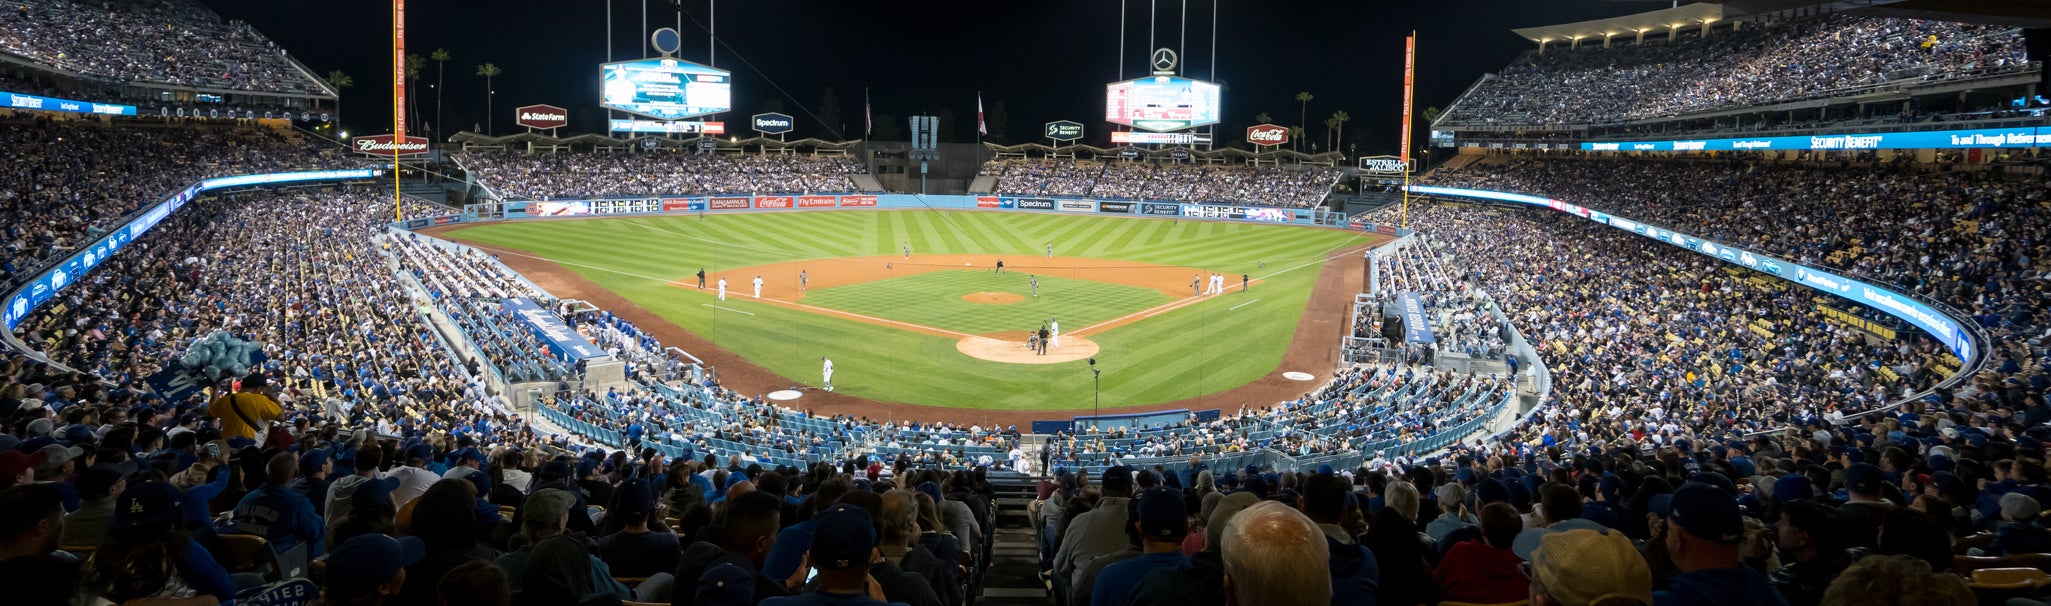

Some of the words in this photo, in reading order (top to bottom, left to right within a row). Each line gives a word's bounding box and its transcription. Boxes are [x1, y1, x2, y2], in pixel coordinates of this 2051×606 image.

[549, 113, 565, 121] Farm
[756, 119, 788, 127] Spectrum
[1250, 129, 1284, 141] Coca-Cola
[1951, 135, 1959, 145] To
[1960, 135, 1974, 145] and
[1975, 134, 2006, 147] Through
[357, 140, 427, 151] Budweiser
[1810, 136, 1845, 149] SECURITY
[1370, 164, 1405, 172] JALISCO
[760, 198, 788, 207] Coca-Cola
[799, 198, 809, 206] Fly
[1408, 313, 1426, 331] DODGER
[130, 497, 144, 513] LA
